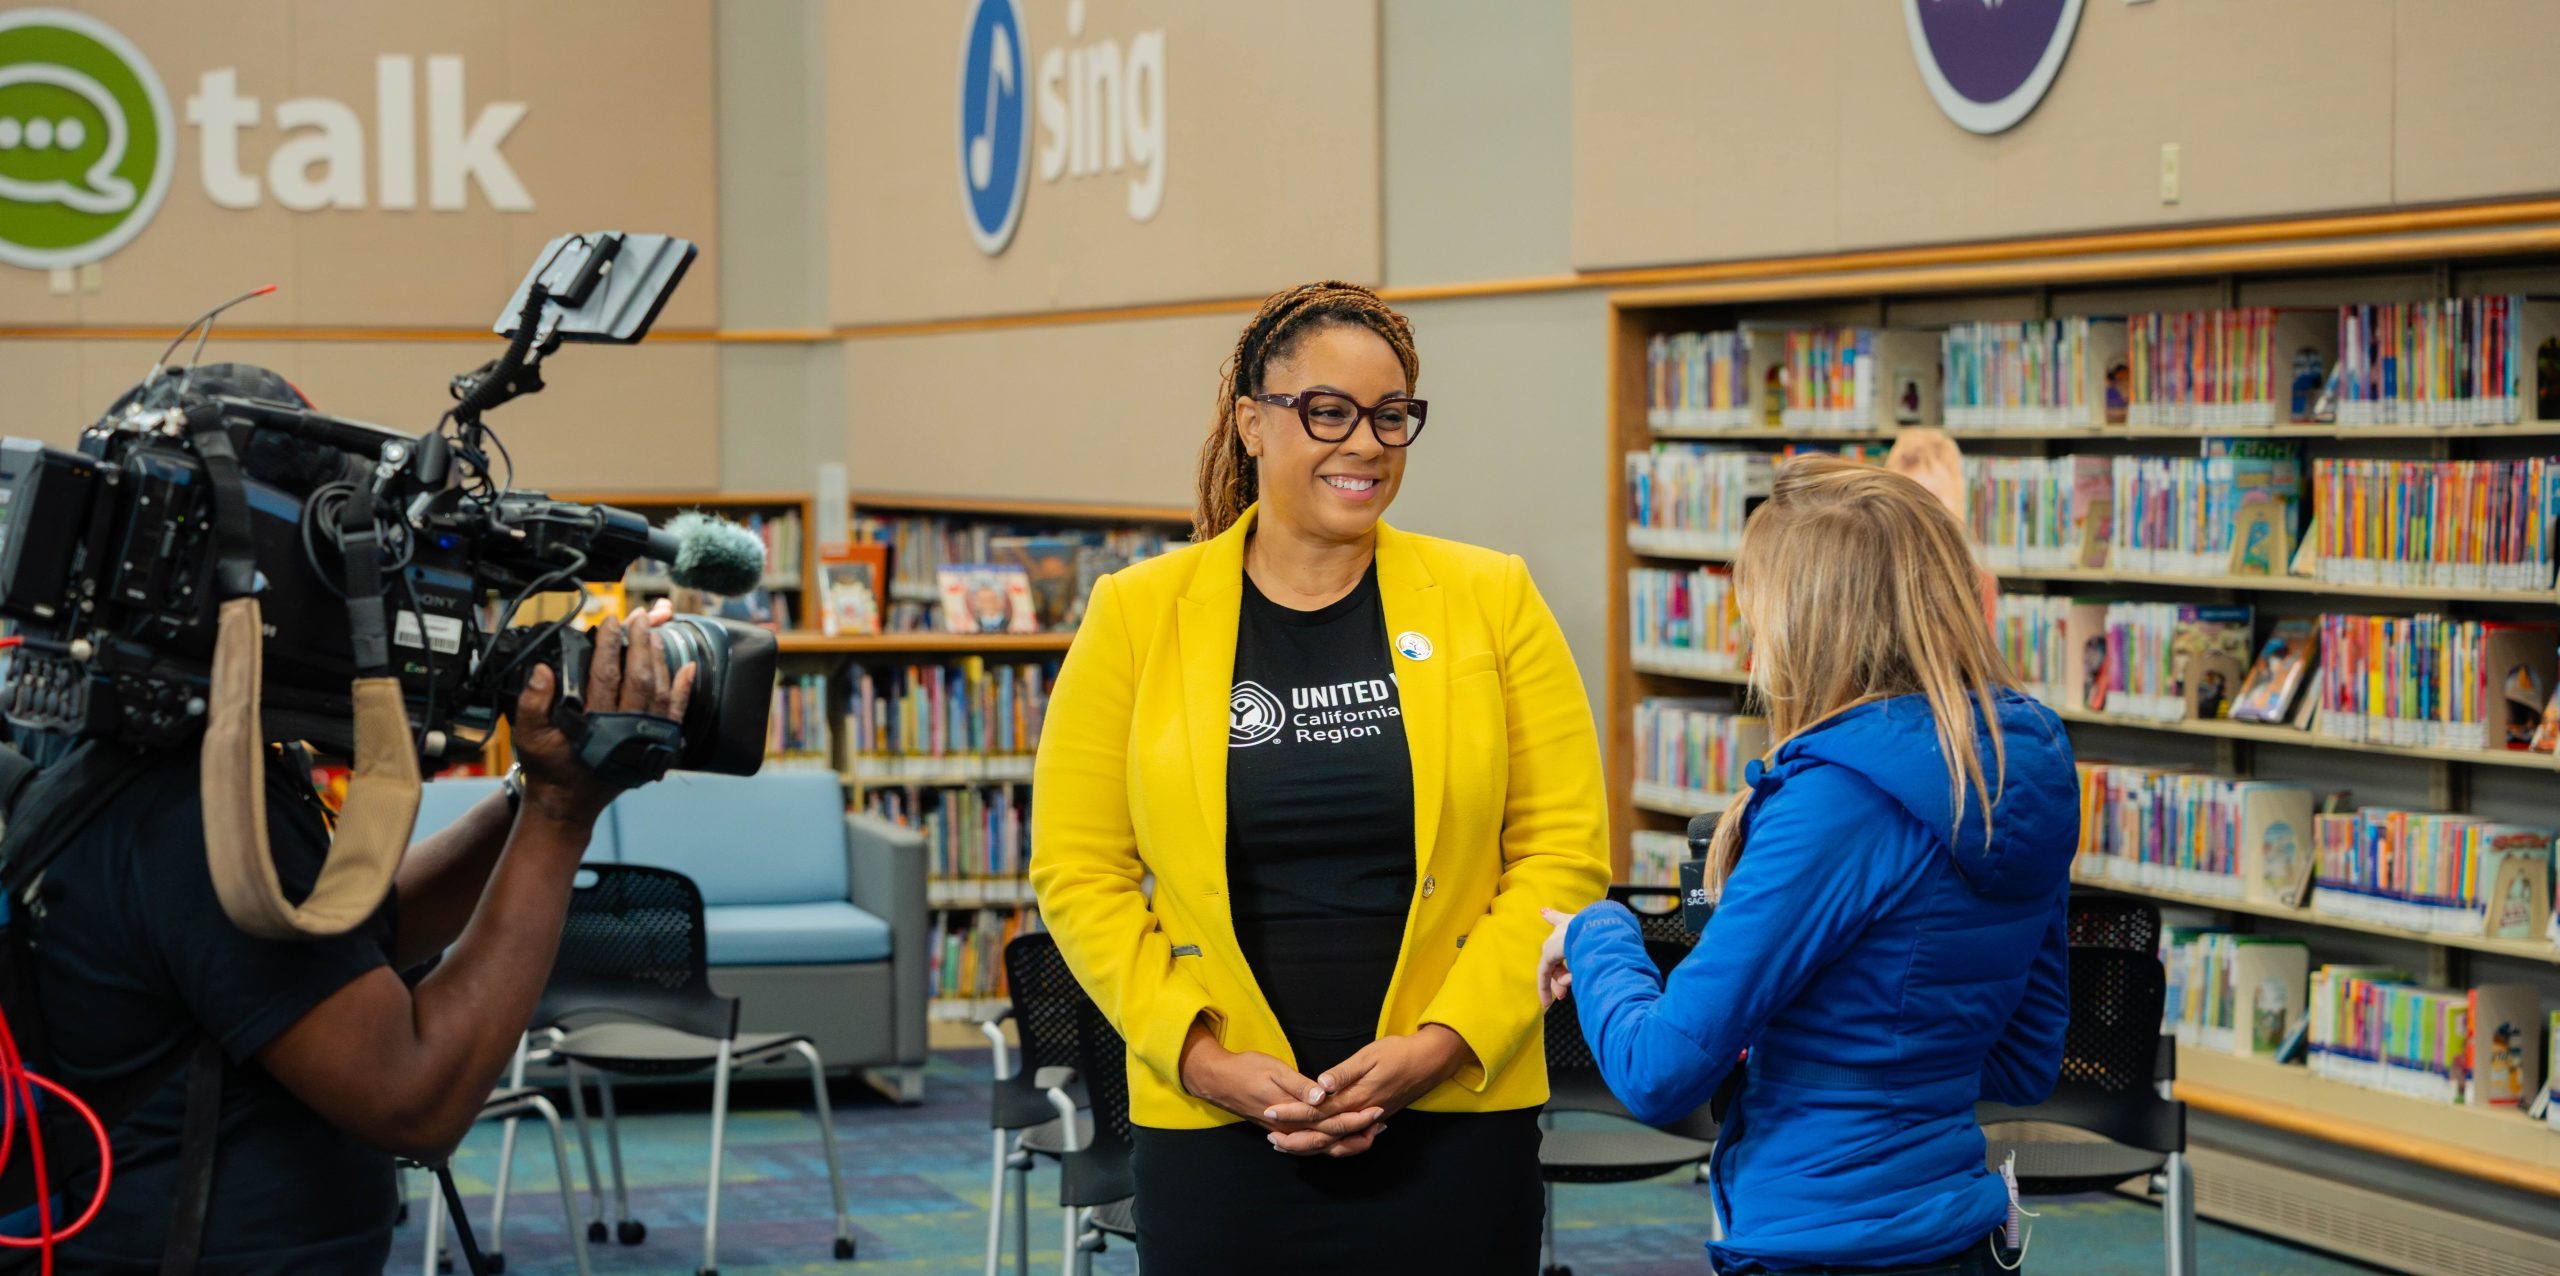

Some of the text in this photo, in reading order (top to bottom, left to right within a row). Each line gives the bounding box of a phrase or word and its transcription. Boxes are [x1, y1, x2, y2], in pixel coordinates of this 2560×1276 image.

[1038, 0, 1166, 220] sing
[185, 54, 536, 211] talk
[415, 593, 458, 608] ONY
[1291, 679, 1389, 709] UNITED
[1293, 705, 1400, 726] California
[1296, 725, 1381, 743] Region
